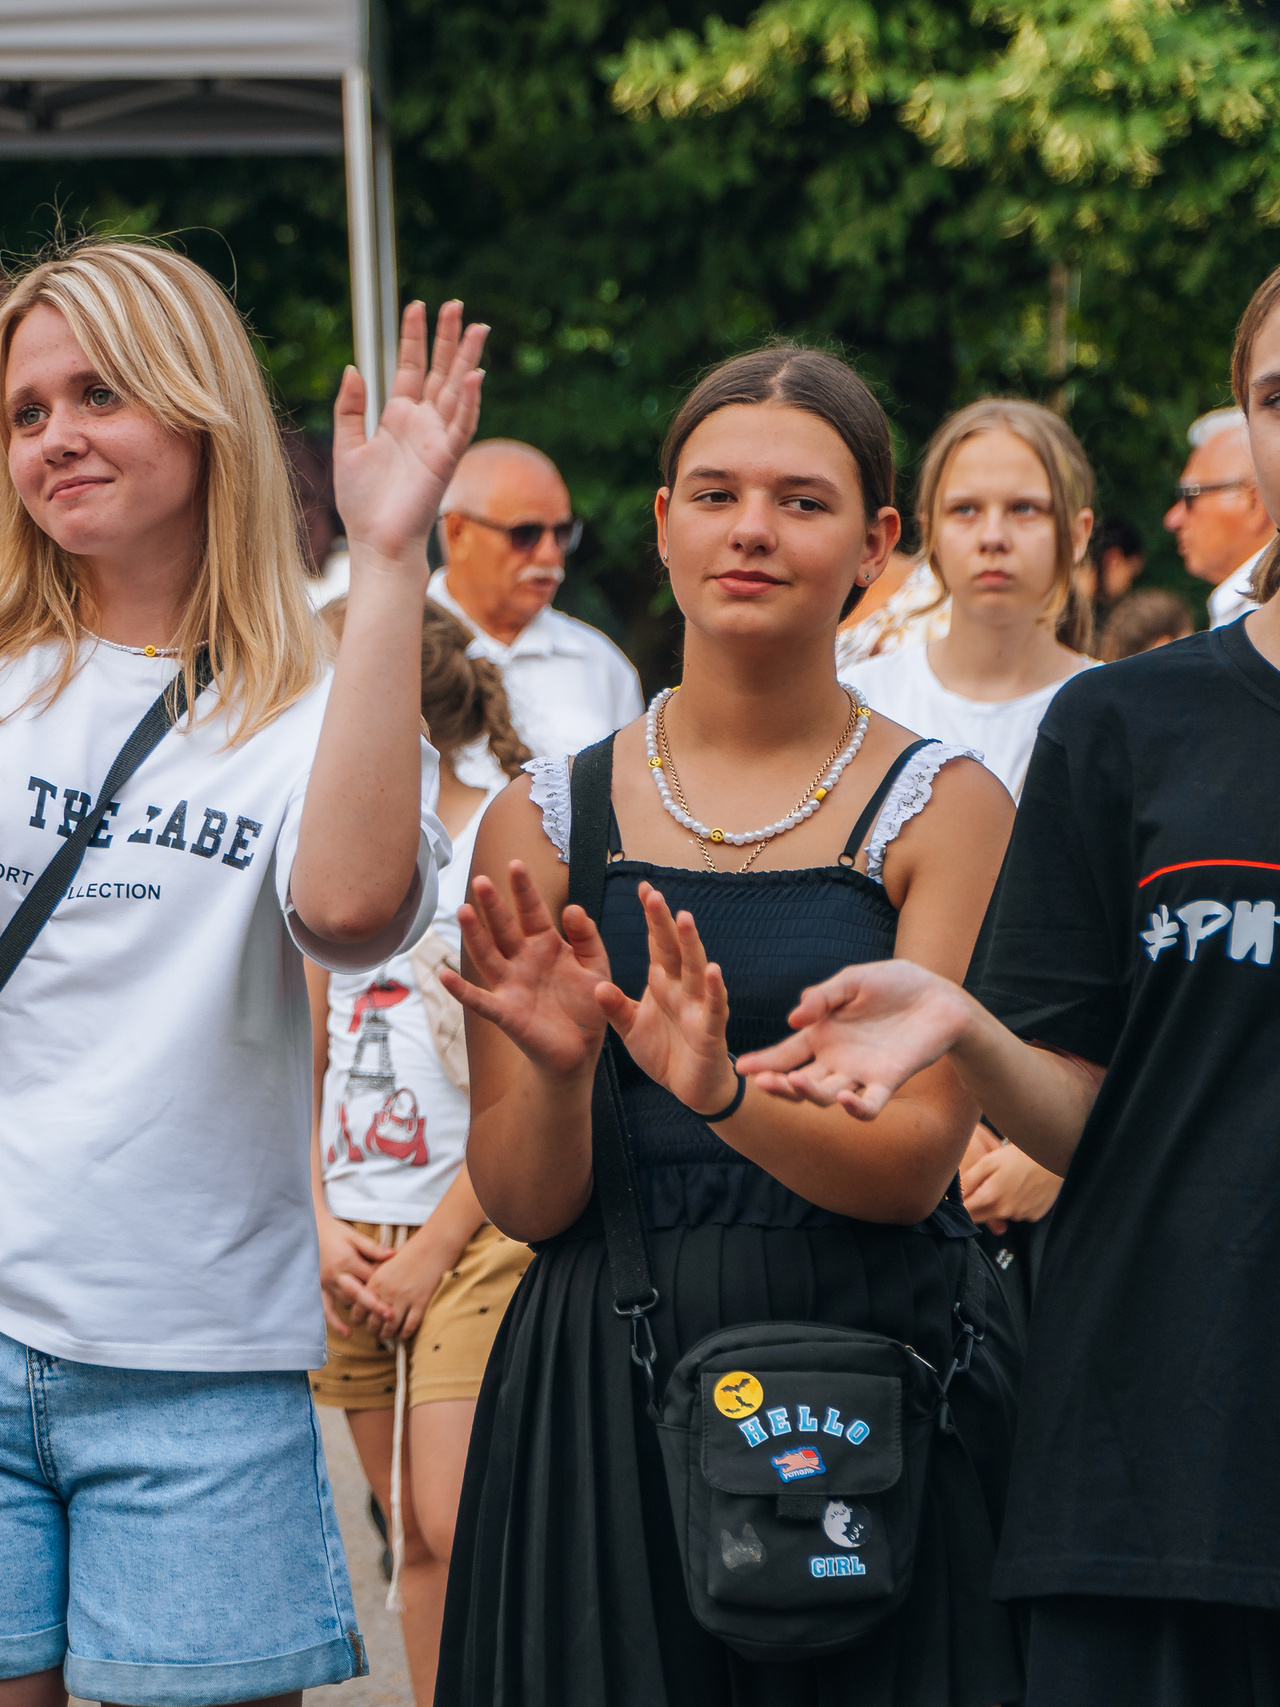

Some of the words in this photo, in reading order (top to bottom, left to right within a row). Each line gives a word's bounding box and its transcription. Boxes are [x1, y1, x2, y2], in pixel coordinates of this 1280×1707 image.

[67, 882, 161, 900] LLECTION
[1141, 900, 1280, 965] #РИ
[737, 1405, 870, 1448] HELLO
[809, 1555, 866, 1578] GIRL
